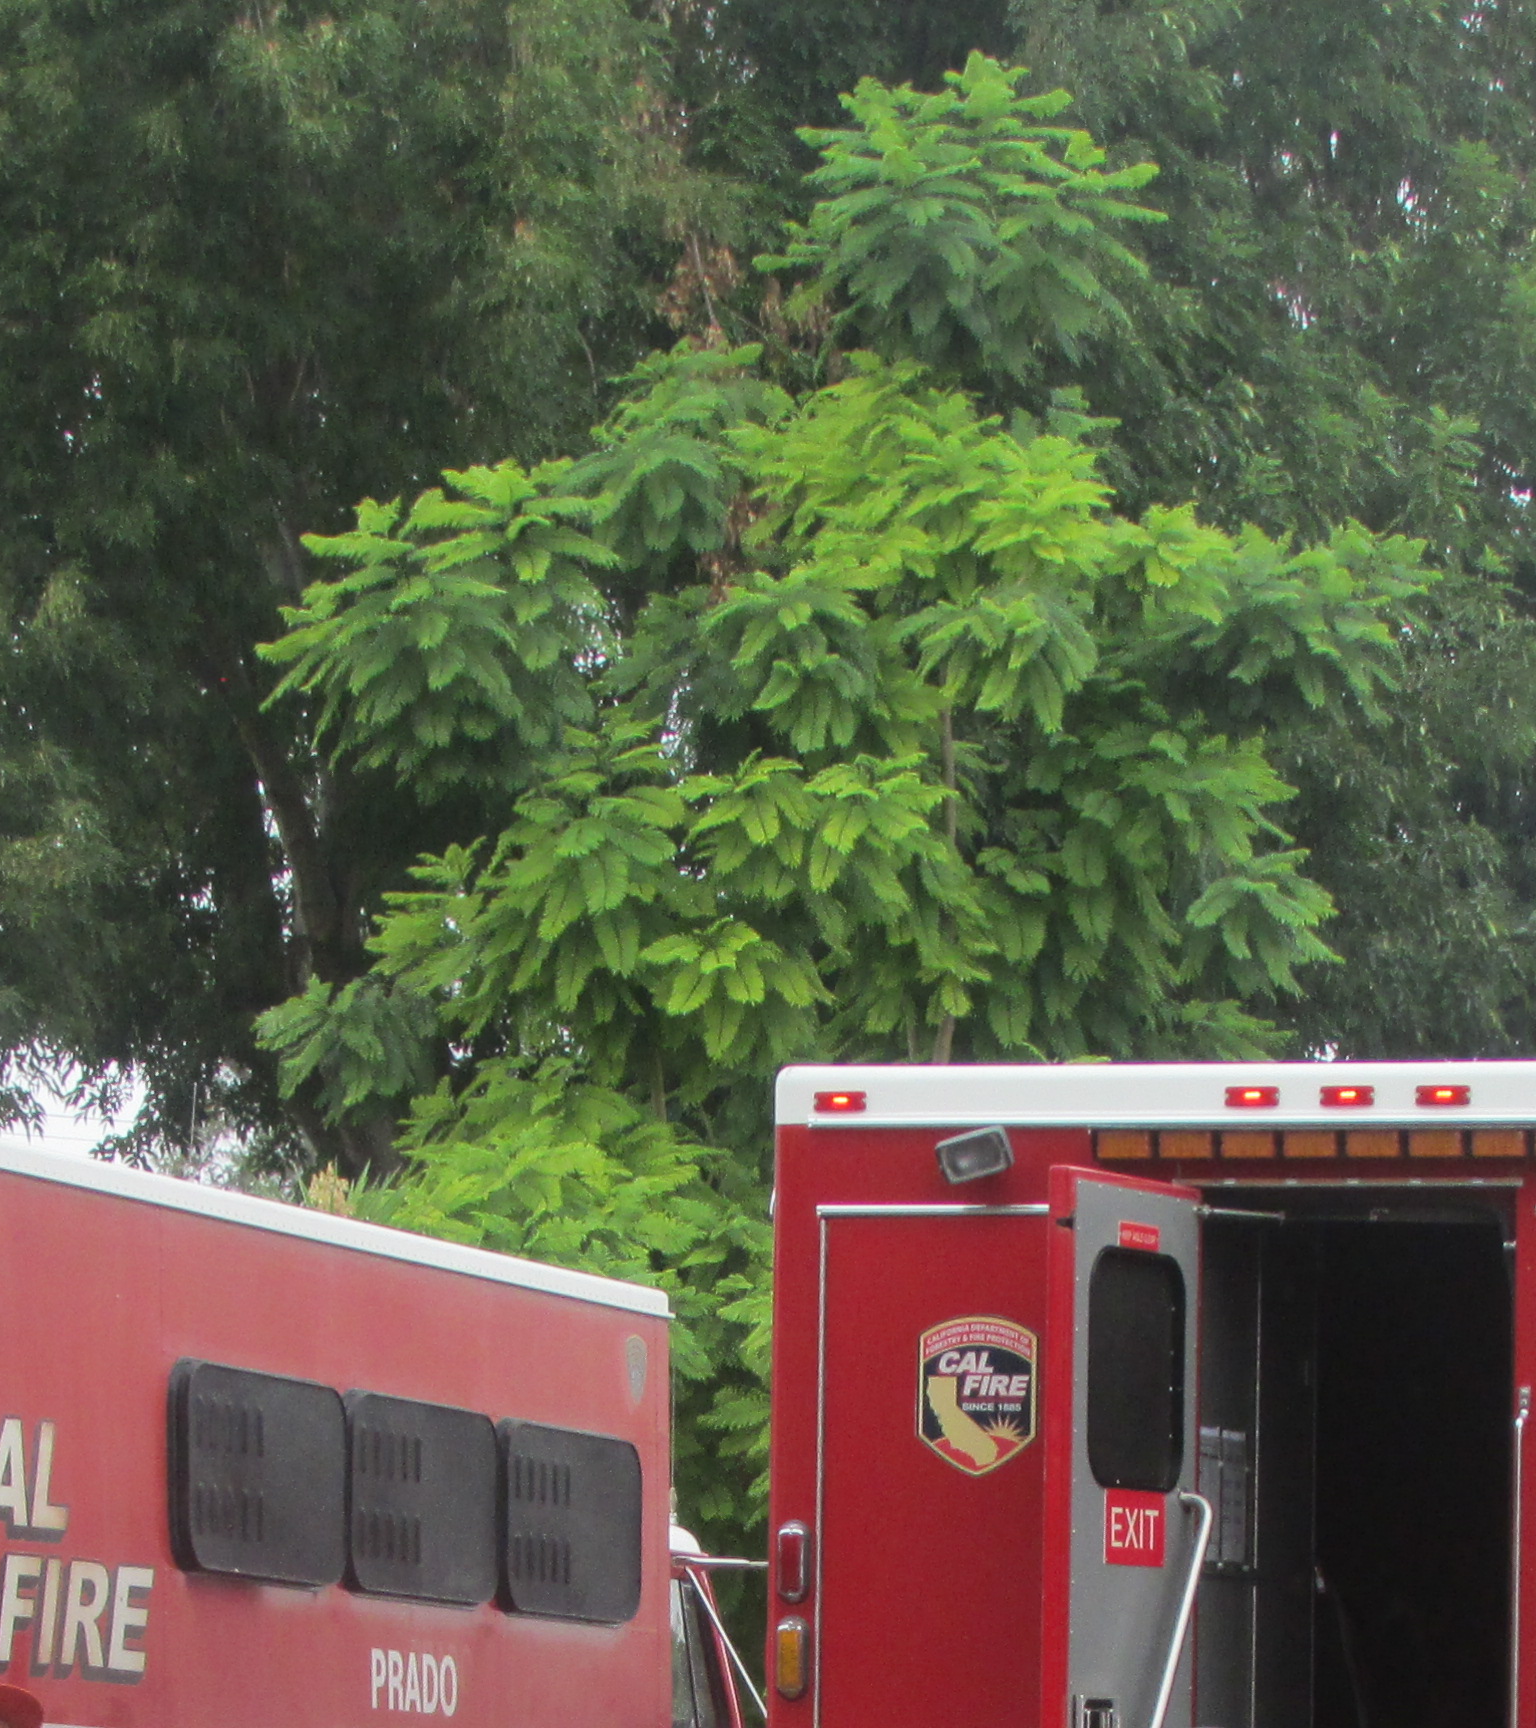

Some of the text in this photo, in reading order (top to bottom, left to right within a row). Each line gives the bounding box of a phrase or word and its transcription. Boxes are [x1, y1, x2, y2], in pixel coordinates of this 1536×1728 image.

[927, 1324, 969, 1345] CALIFORNIA
[970, 1323, 1019, 1340] DEPARTMENT
[938, 1351, 994, 1374] CAL
[964, 1374, 1030, 1397] FIRE
[962, 1402, 995, 1412] SINCE
[1111, 1507, 1159, 1550] EXIT
[371, 1648, 458, 1717] PRADO
